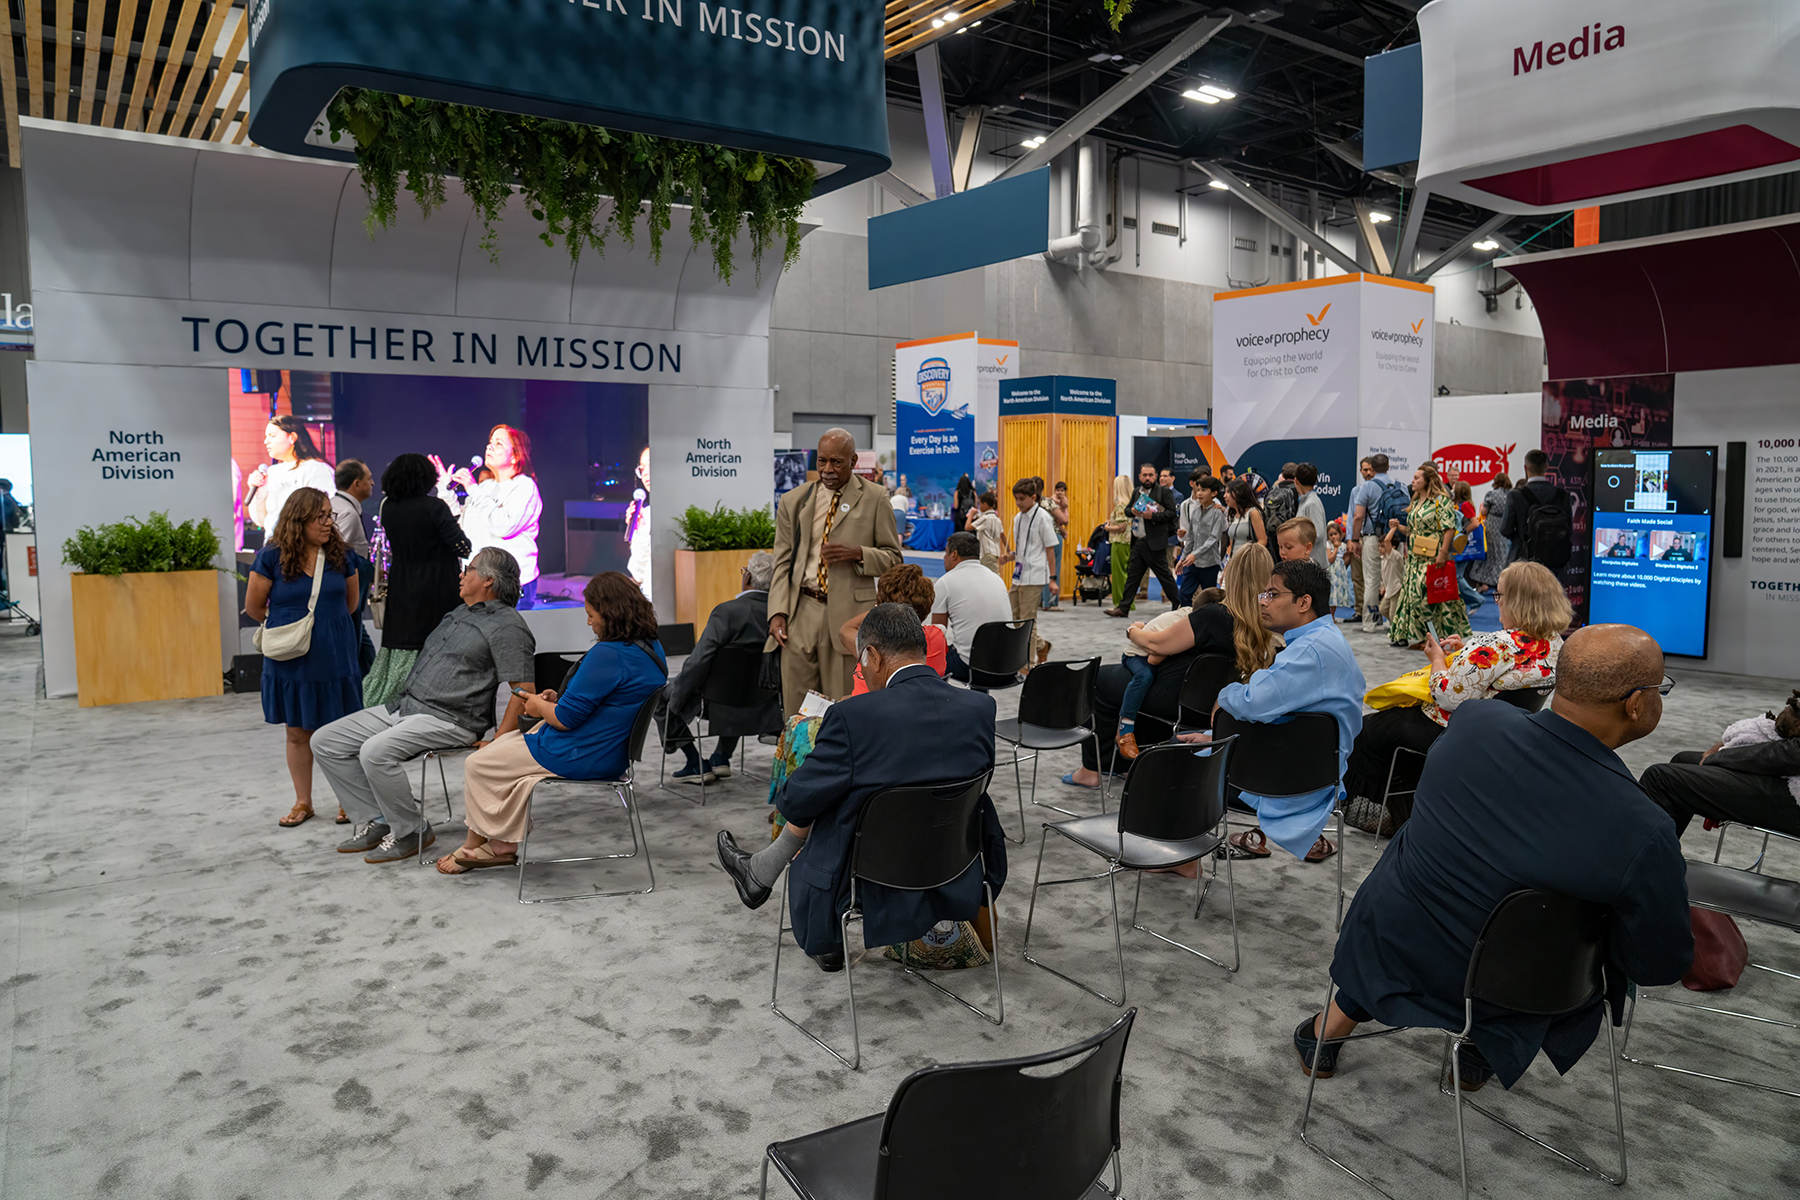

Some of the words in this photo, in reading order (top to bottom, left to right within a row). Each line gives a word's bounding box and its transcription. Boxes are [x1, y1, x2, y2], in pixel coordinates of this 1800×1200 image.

[699, 3, 845, 62] MISSION
[1513, 22, 1625, 76] Media
[1236, 333, 1264, 347] voice
[1274, 327, 1330, 347] prophecy
[181, 316, 436, 362] TOGETHER
[452, 331, 497, 365] IN
[517, 335, 682, 373] MISSION
[1244, 355, 1282, 366] Equipping
[1283, 353, 1296, 362] the
[1298, 350, 1322, 361] World
[1248, 368, 1258, 378] for
[1260, 366, 1282, 378] Christ
[1284, 366, 1293, 376] to
[1295, 364, 1318, 374] Come
[1570, 414, 1618, 429] Media
[110, 430, 164, 444] North
[697, 438, 731, 449] North
[911, 436, 928, 446] Every
[929, 435, 941, 445] Day
[1758, 439, 1794, 449] 10,000
[92, 448, 181, 462] American
[909, 446, 934, 455] Exercise
[935, 445, 942, 454] in
[943, 444, 960, 454] Faith
[686, 452, 742, 463] American
[102, 465, 174, 479] Division
[692, 466, 737, 477] Division
